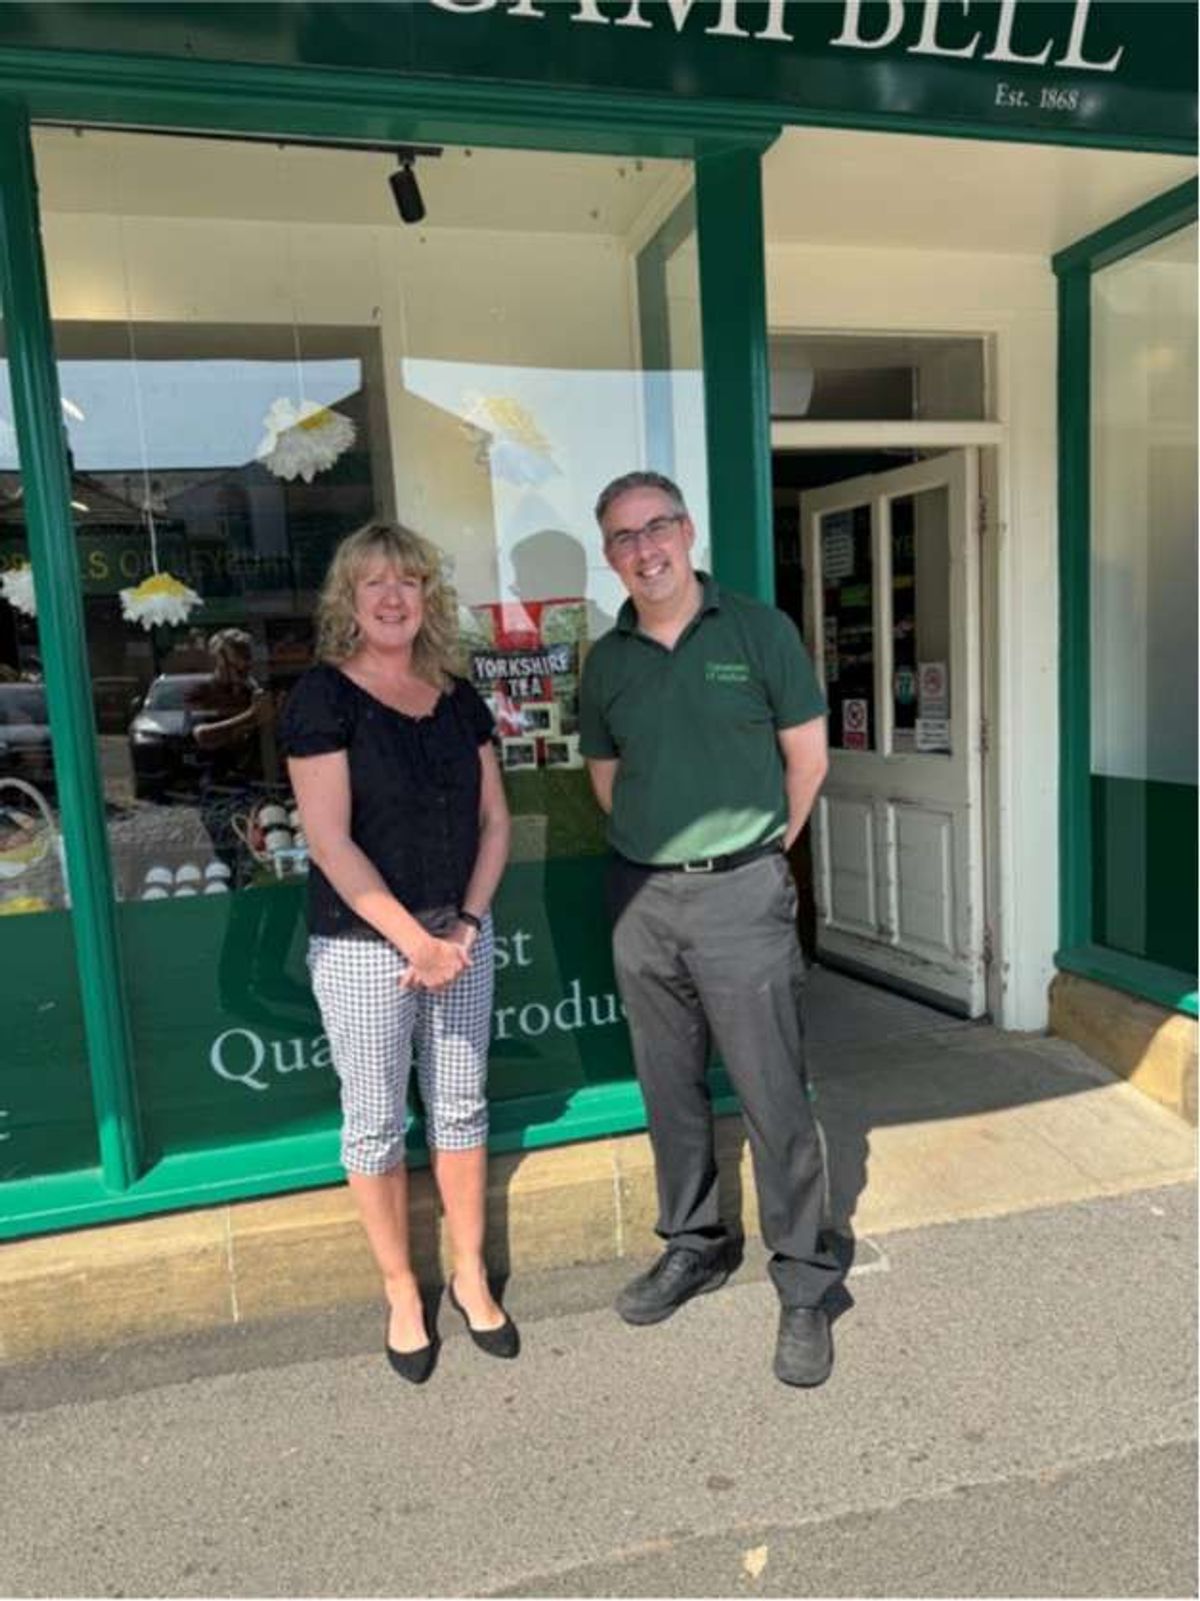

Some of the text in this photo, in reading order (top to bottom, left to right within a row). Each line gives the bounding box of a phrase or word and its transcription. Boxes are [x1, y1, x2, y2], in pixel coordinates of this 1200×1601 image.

[424, 0, 1126, 73] BELL
[995, 82, 1079, 111] Est. 1868
[474, 653, 569, 678] YORKSHIRE
[507, 677, 543, 697] TEA
[494, 929, 533, 968] st
[210, 979, 629, 1090] Qua rodu
